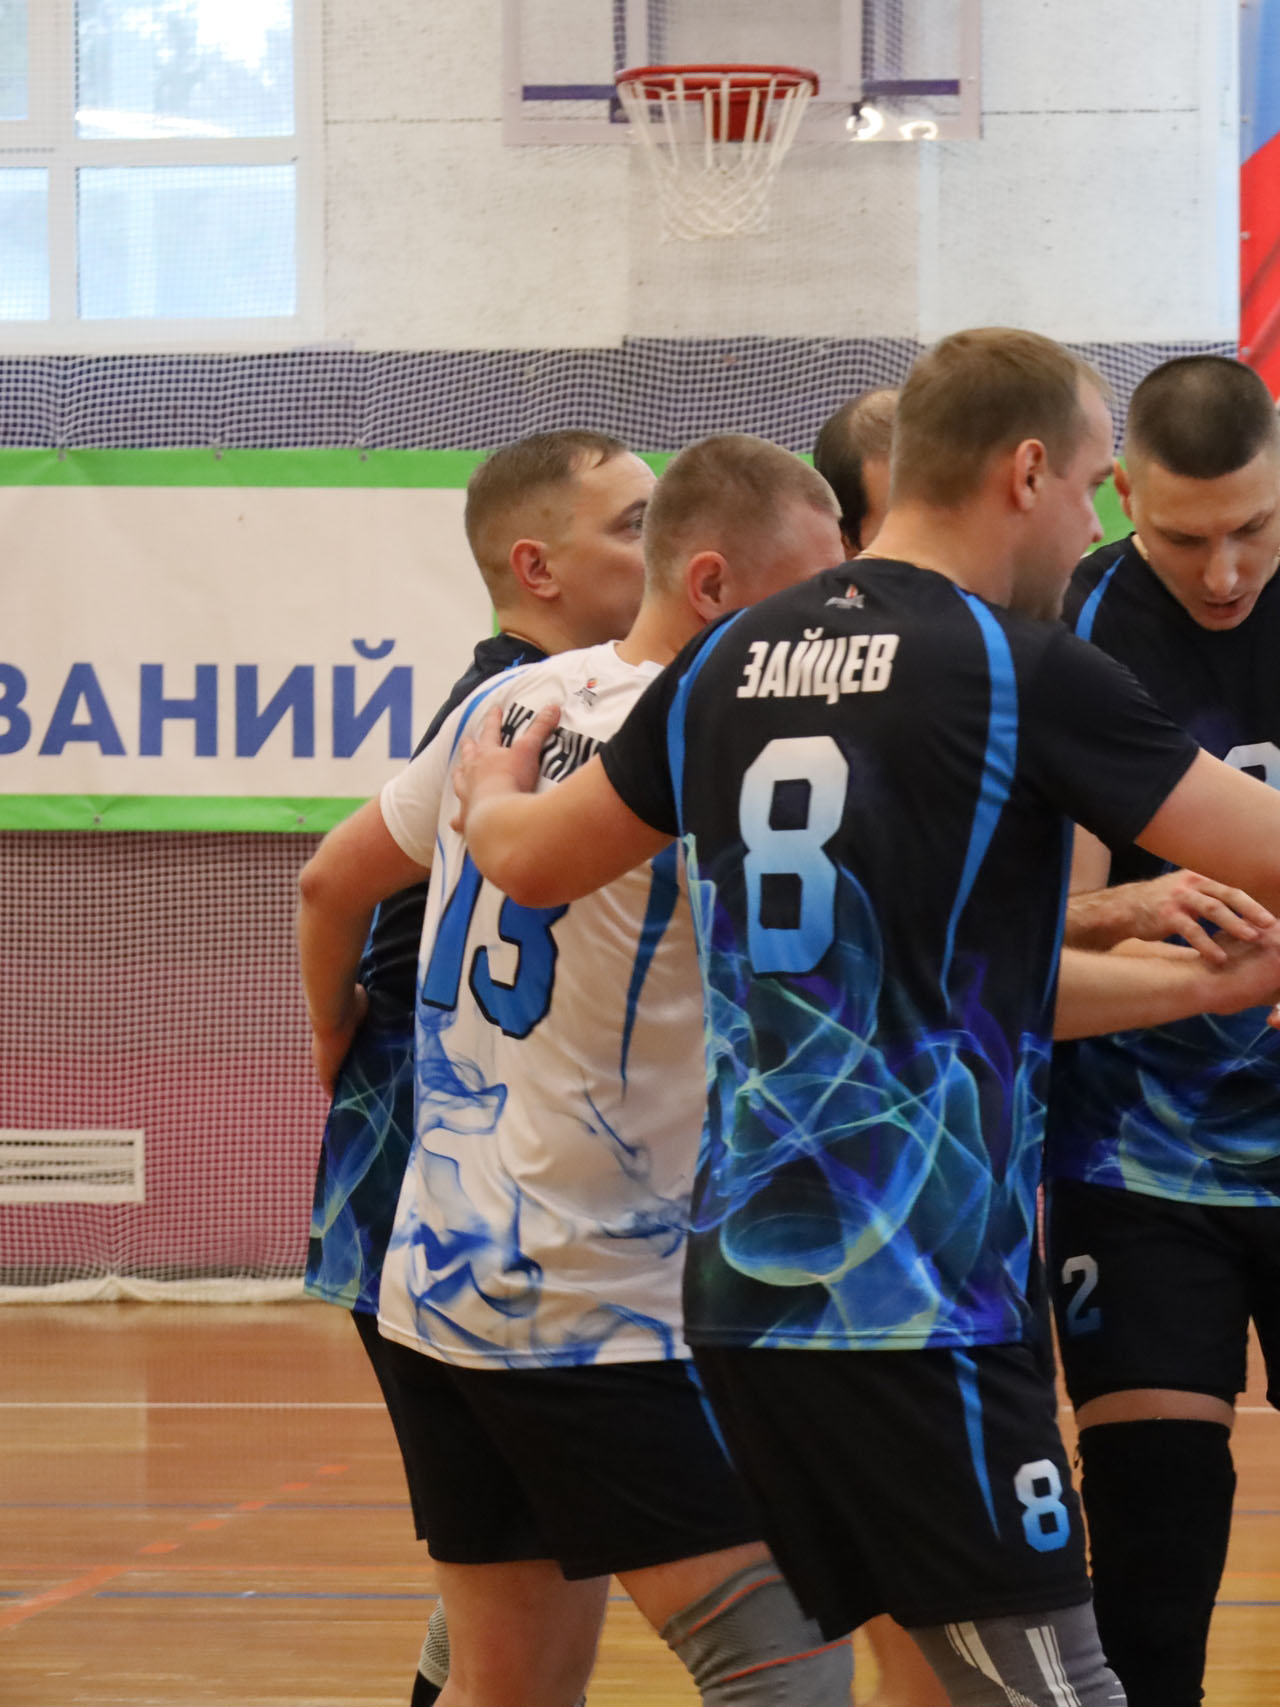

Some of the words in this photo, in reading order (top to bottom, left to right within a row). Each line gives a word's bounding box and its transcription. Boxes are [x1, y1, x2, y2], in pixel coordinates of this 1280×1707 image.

[737, 628, 899, 704] ЗАЙЦЕВ
[737, 735, 850, 975] 8
[1061, 1254, 1101, 1335] 2
[1015, 1459, 1070, 1553] 8
